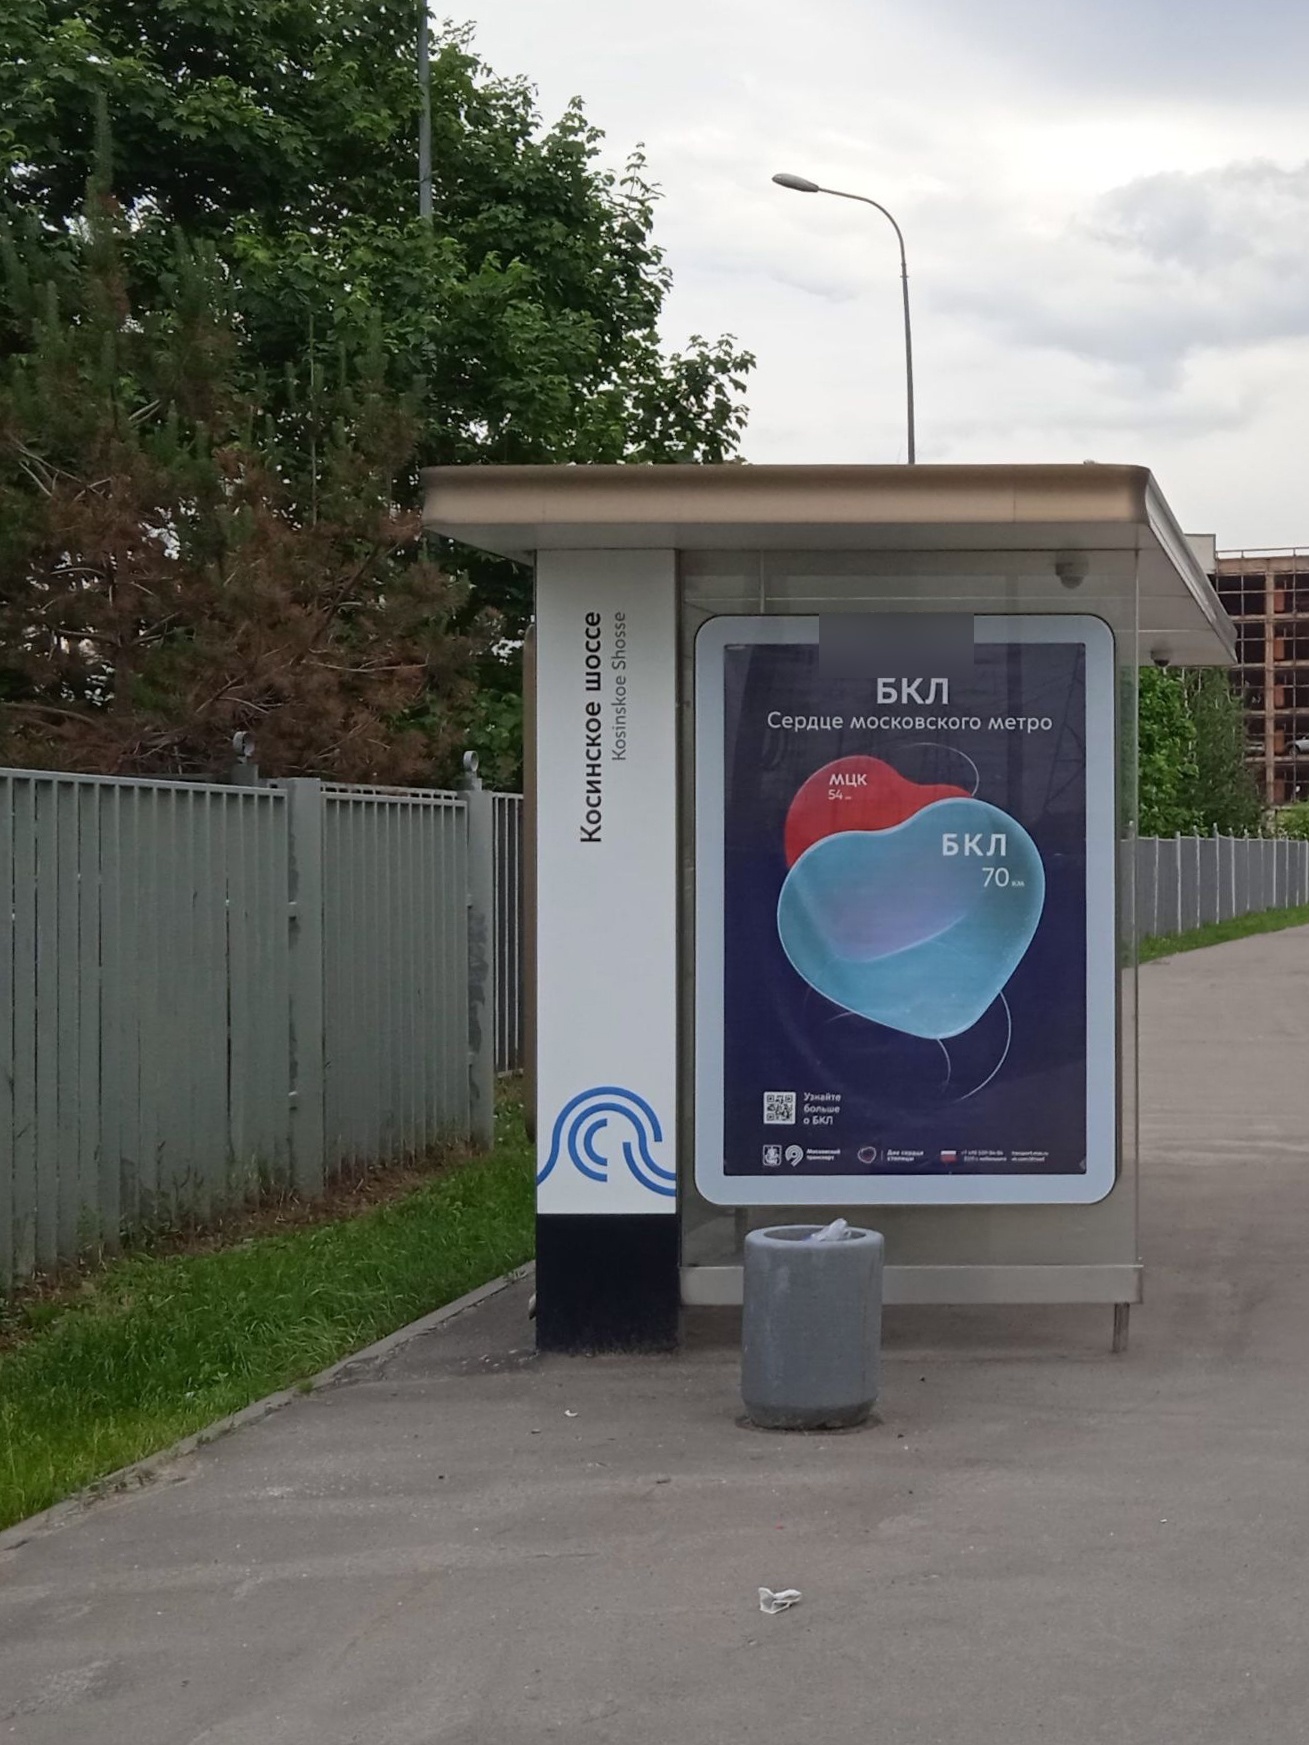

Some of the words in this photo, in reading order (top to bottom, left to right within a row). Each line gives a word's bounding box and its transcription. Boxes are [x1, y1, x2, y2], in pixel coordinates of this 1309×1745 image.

[585, 611, 601, 692] шоссе
[611, 611, 627, 670] Shosse
[876, 677, 949, 705] БКЛ
[611, 674, 627, 761] Kosinskoe
[766, 711, 844, 732] Сердце
[850, 715, 981, 730] московского
[987, 715, 1053, 734] метро
[580, 701, 602, 843] Косинское
[828, 773, 868, 788] МЦК
[827, 789, 844, 800] 54
[942, 833, 1007, 857] БКЛ
[981, 867, 1010, 888] 70
[803, 1092, 841, 1102] Узнайте
[803, 1103, 841, 1113] больше
[803, 1117, 810, 1125] о
[812, 1115, 834, 1125] БКЛ
